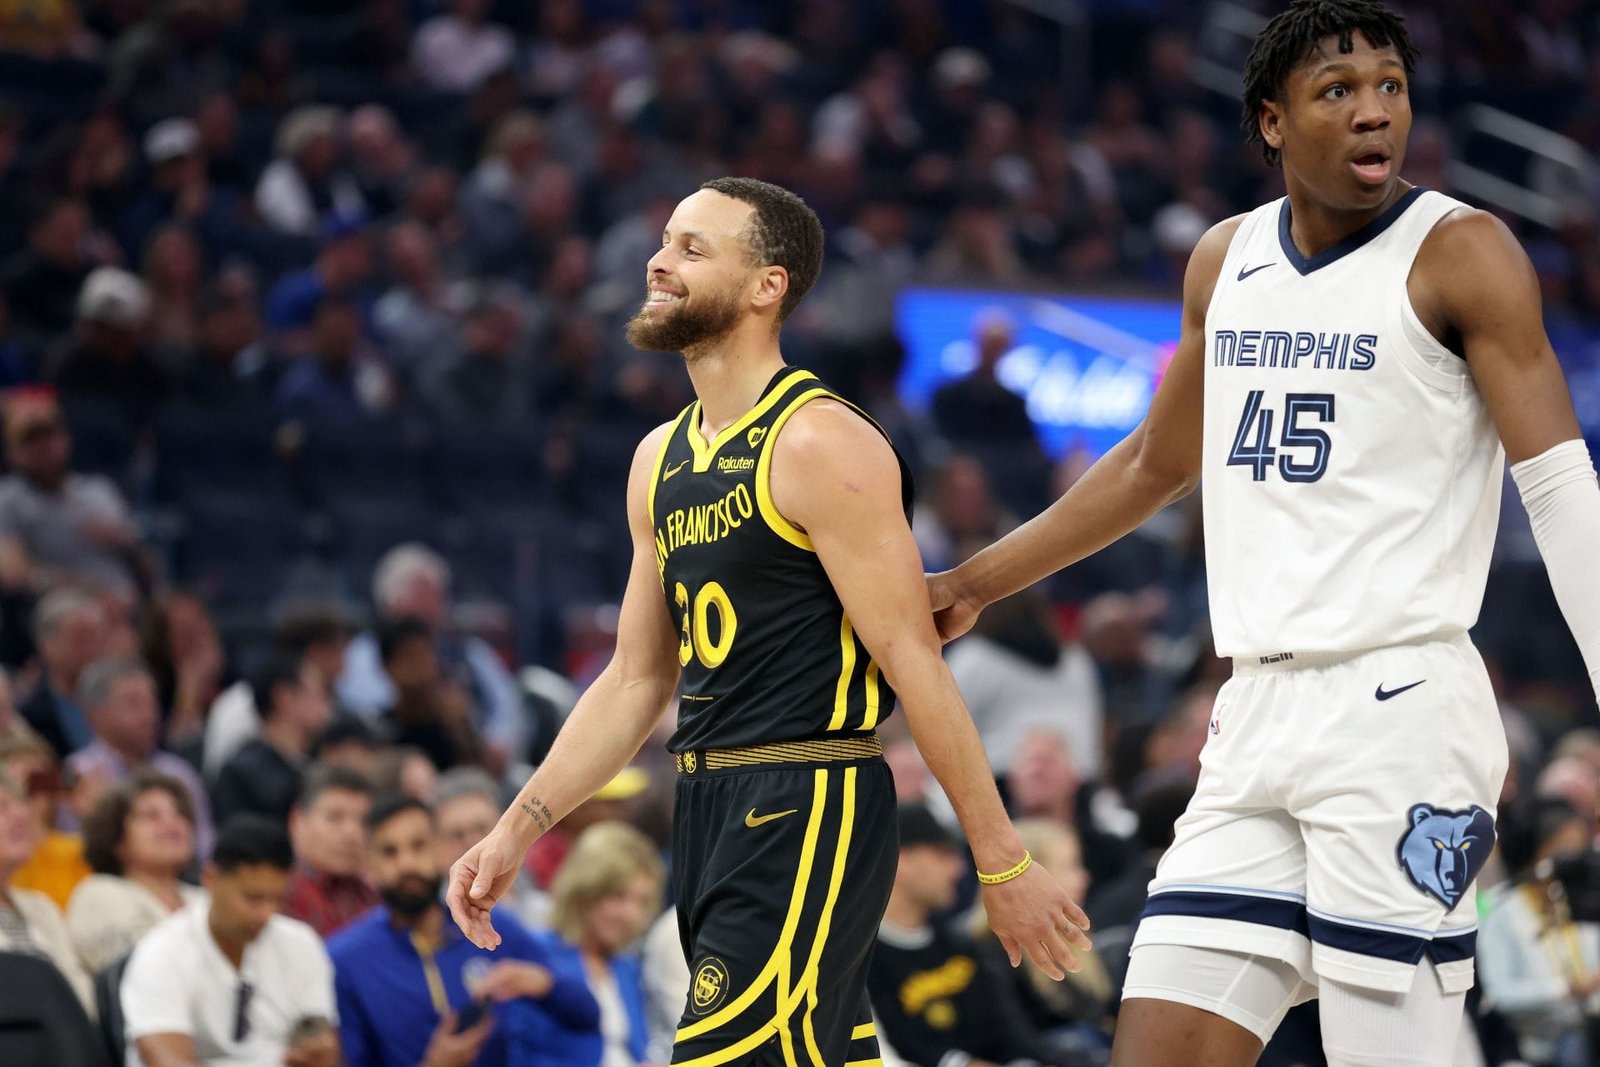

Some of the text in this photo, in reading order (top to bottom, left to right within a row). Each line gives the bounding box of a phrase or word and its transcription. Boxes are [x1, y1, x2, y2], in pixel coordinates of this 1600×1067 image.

[1214, 330, 1378, 371] MEMPHIS
[717, 456, 755, 470] Rakuten
[1226, 390, 1335, 483] 45
[666, 482, 753, 552] FRANCISCO
[675, 581, 738, 669] 30
